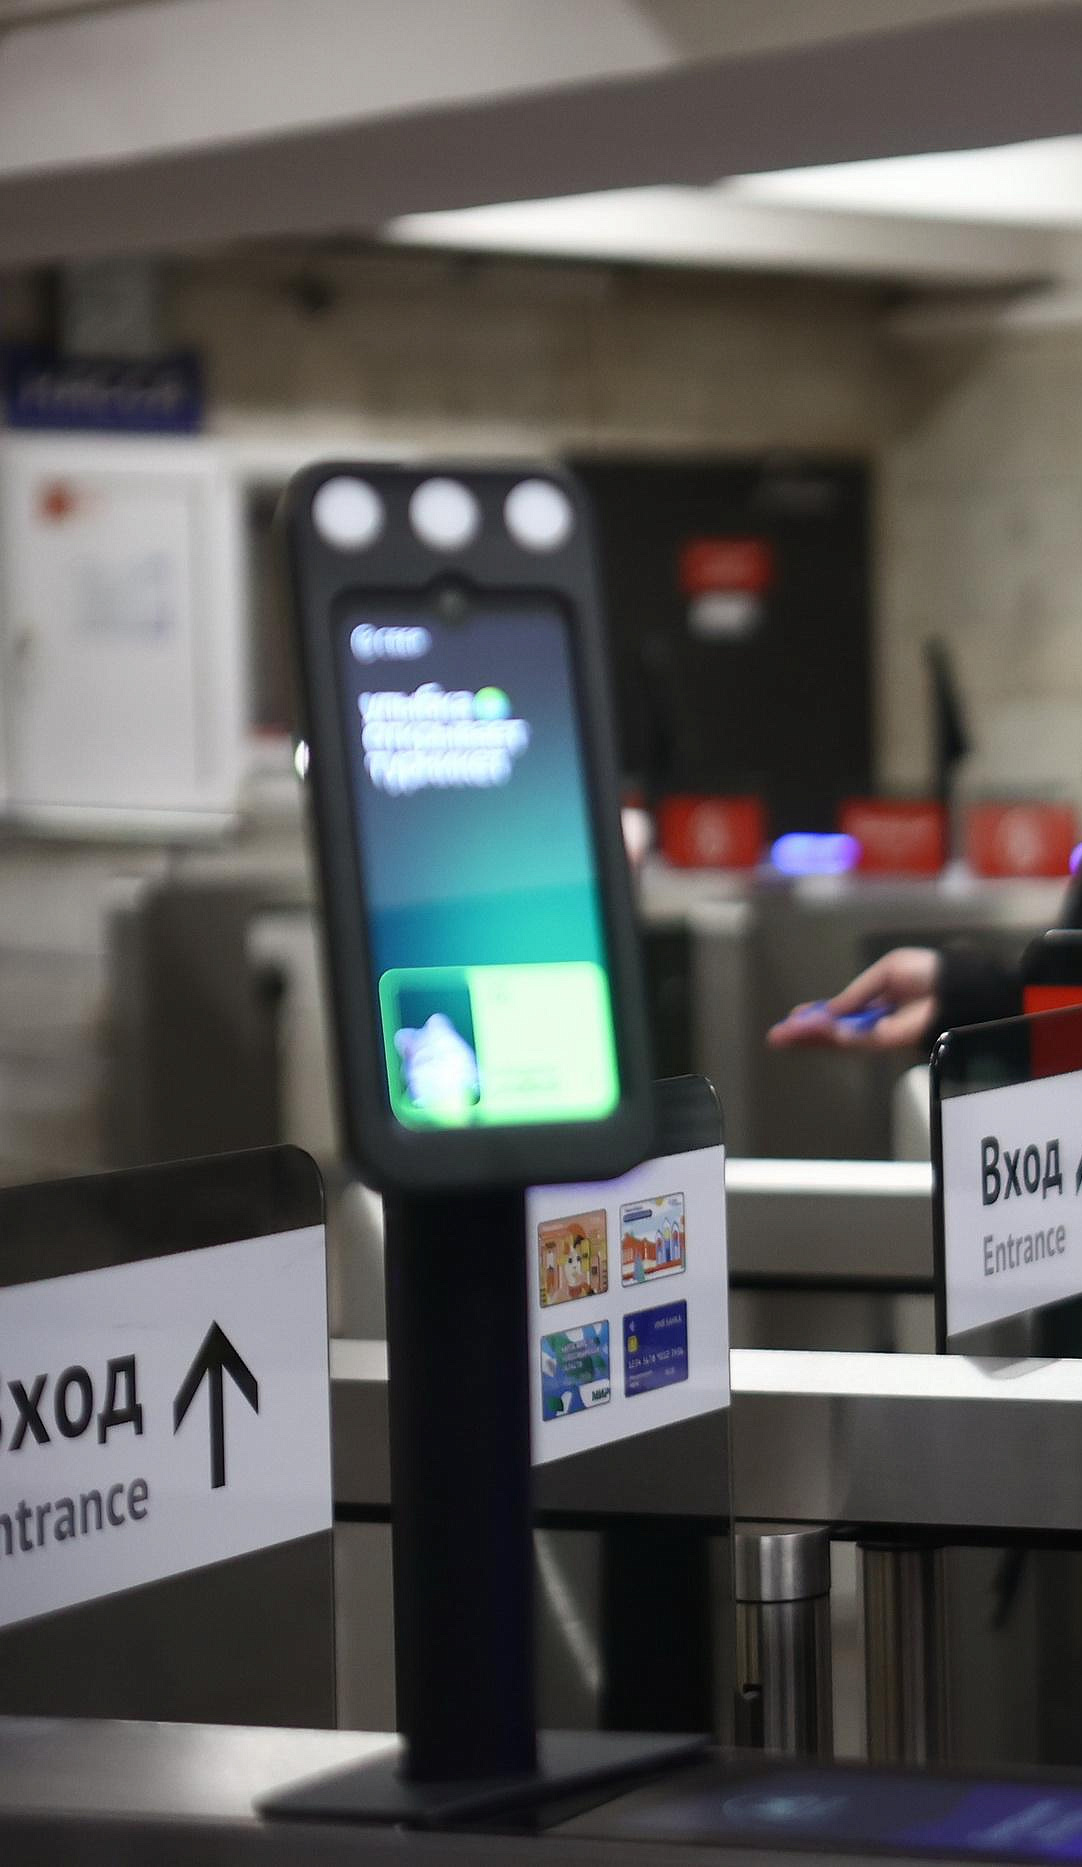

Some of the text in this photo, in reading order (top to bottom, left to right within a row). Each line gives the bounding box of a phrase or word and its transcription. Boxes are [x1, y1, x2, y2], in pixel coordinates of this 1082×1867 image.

[981, 1135, 1063, 1206] Вход
[983, 1224, 1066, 1276] Entrance
[0, 1353, 143, 1451] ход
